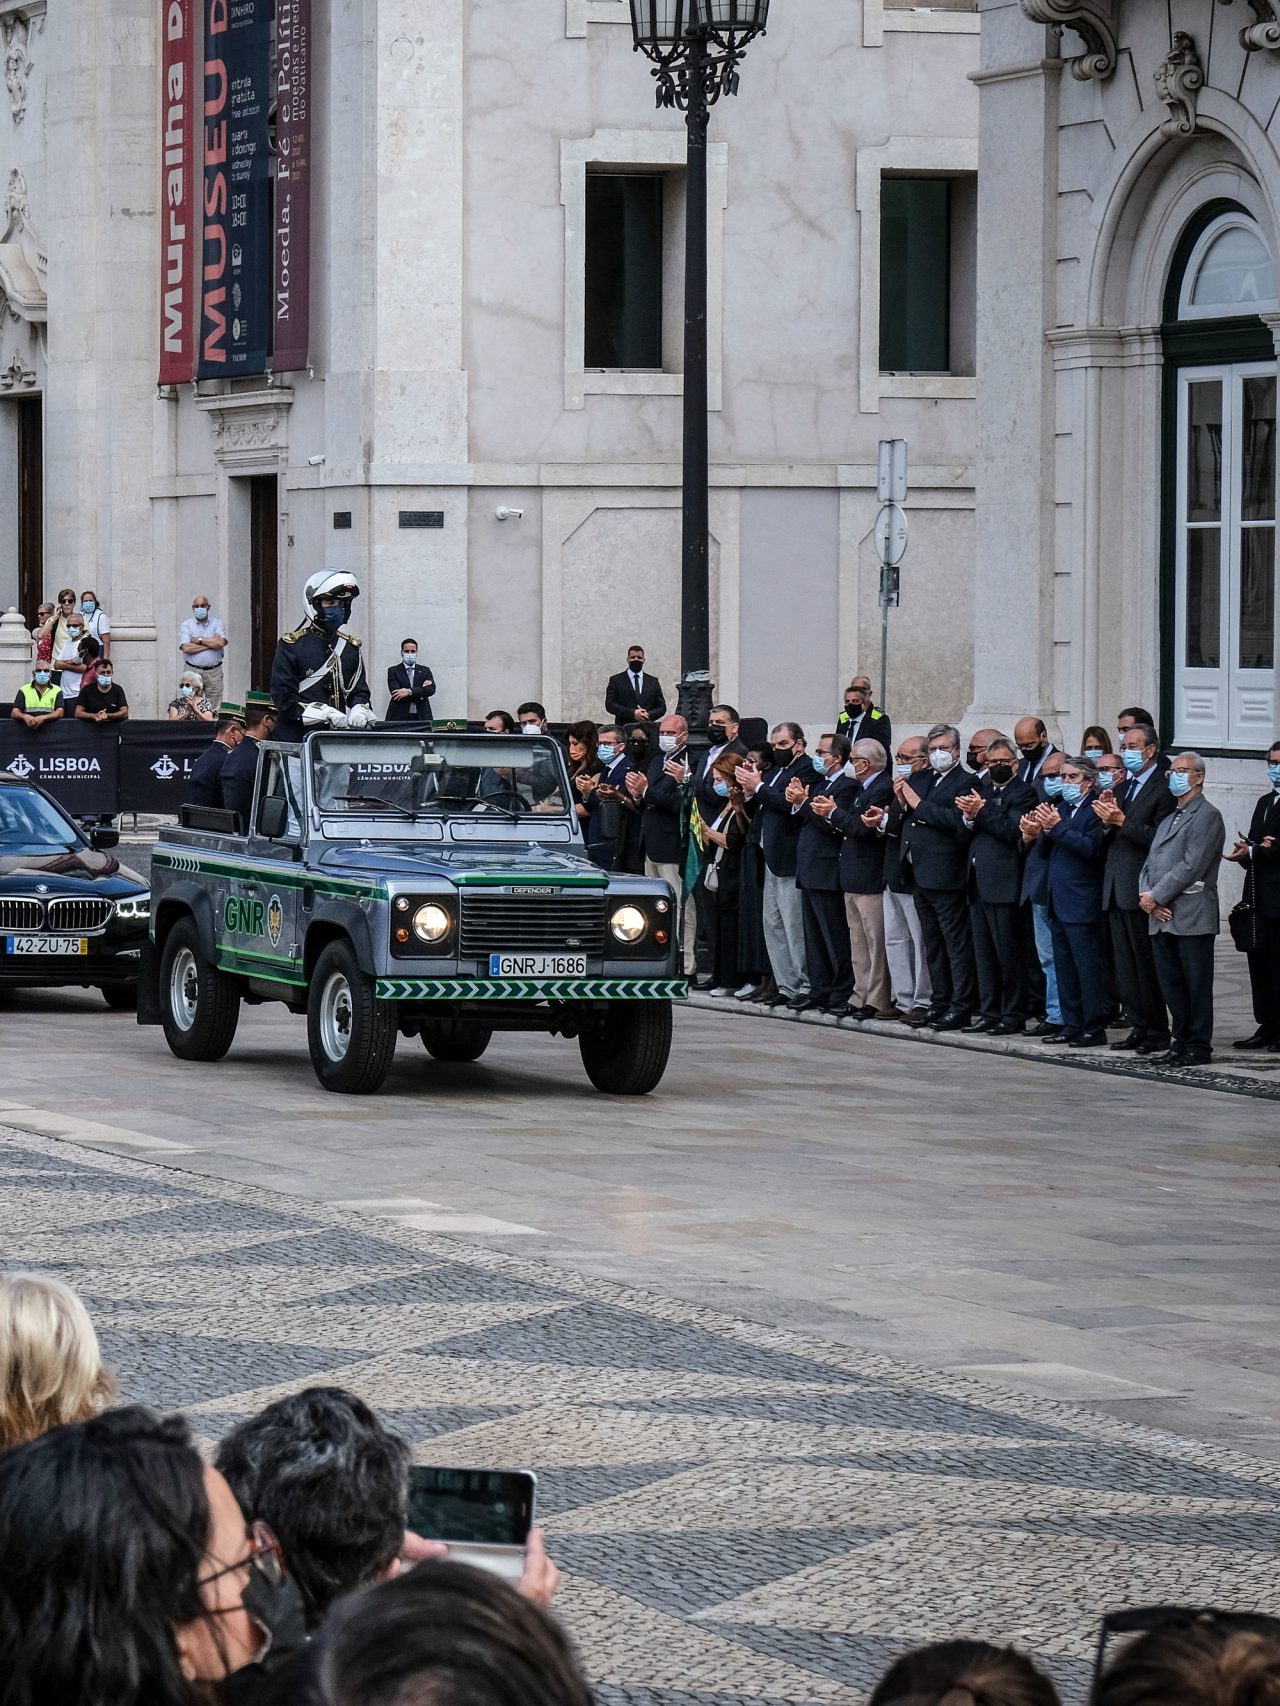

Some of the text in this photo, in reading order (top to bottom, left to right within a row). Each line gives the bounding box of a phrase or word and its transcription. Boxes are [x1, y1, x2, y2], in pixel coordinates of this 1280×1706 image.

[293, 43, 299, 53] e
[282, 104, 290, 122] e
[299, 99, 306, 120] do
[278, 137, 290, 181] Fé
[164, 62, 186, 353] Muralha
[204, 58, 228, 363] MUSEU
[277, 194, 291, 321] Moeda,
[39, 757, 102, 772] LISBOA
[225, 896, 265, 937] GNR
